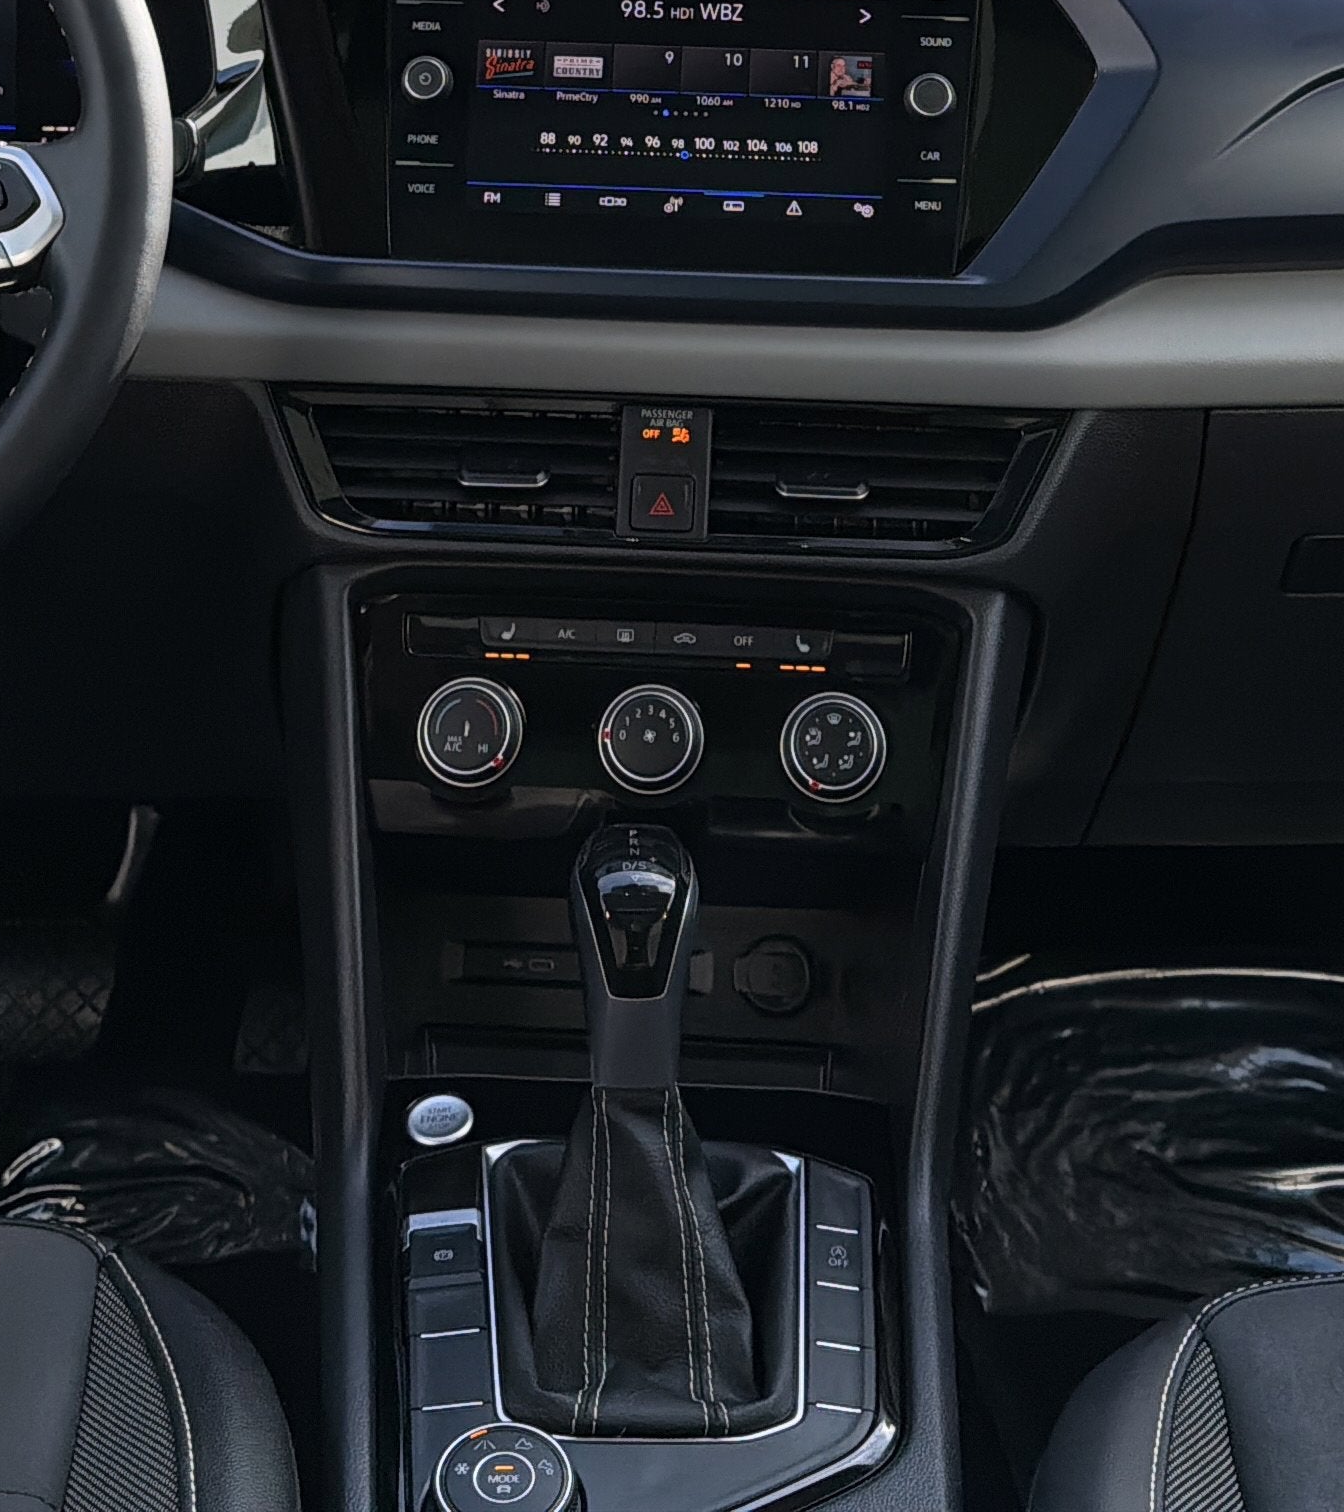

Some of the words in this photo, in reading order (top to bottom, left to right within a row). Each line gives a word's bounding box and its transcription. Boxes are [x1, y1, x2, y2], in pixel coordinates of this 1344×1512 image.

[620, 0, 665, 20] 98.5
[670, 7, 695, 20] HD1
[699, 2, 745, 22] WBZ
[411, 20, 442, 32] MEDIA
[919, 36, 953, 48] SOUND
[664, 51, 674, 65] 9
[724, 53, 743, 67] 10
[793, 55, 810, 68] 11
[554, 65, 603, 77] COUNTRY
[492, 88, 526, 100] Sinatra
[555, 89, 599, 105] PrmeCtry
[629, 93, 649, 104] 990
[695, 95, 721, 107] 1060
[763, 97, 789, 108] 1210
[831, 99, 854, 111] 98.1
[406, 134, 440, 146] PHONE
[539, 132, 557, 146] 88
[566, 134, 582, 146] 90
[592, 134, 609, 148] 92
[619, 137, 634, 148] 94
[645, 135, 662, 148] 96
[671, 138, 685, 150] 98
[693, 137, 716, 150] 100
[722, 140, 741, 151] 102
[746, 139, 769, 152] 104
[774, 141, 793, 153] 106
[797, 141, 819, 154] 108
[919, 150, 941, 162] CAR
[407, 183, 437, 194] VOICE
[483, 191, 502, 204] FM
[913, 200, 943, 212] MENU
[640, 408, 694, 420] PASSENGER
[649, 418, 665, 427] AIR
[642, 428, 661, 440] OFF
[557, 628, 577, 641] A/C
[733, 635, 754, 648] OFF
[635, 708, 642, 719] 2
[647, 704, 654, 715] 3
[659, 708, 667, 719] 4
[625, 716, 631, 727] 1
[669, 717, 675, 729] 5
[619, 729, 627, 741] 0
[672, 732, 680, 743] 6
[443, 742, 463, 753] A/C
[477, 743, 489, 754] HI
[629, 838, 639, 846] R
[629, 847, 640, 856] N
[622, 860, 648, 871] D/S
[487, 1473, 521, 1485] MODE
